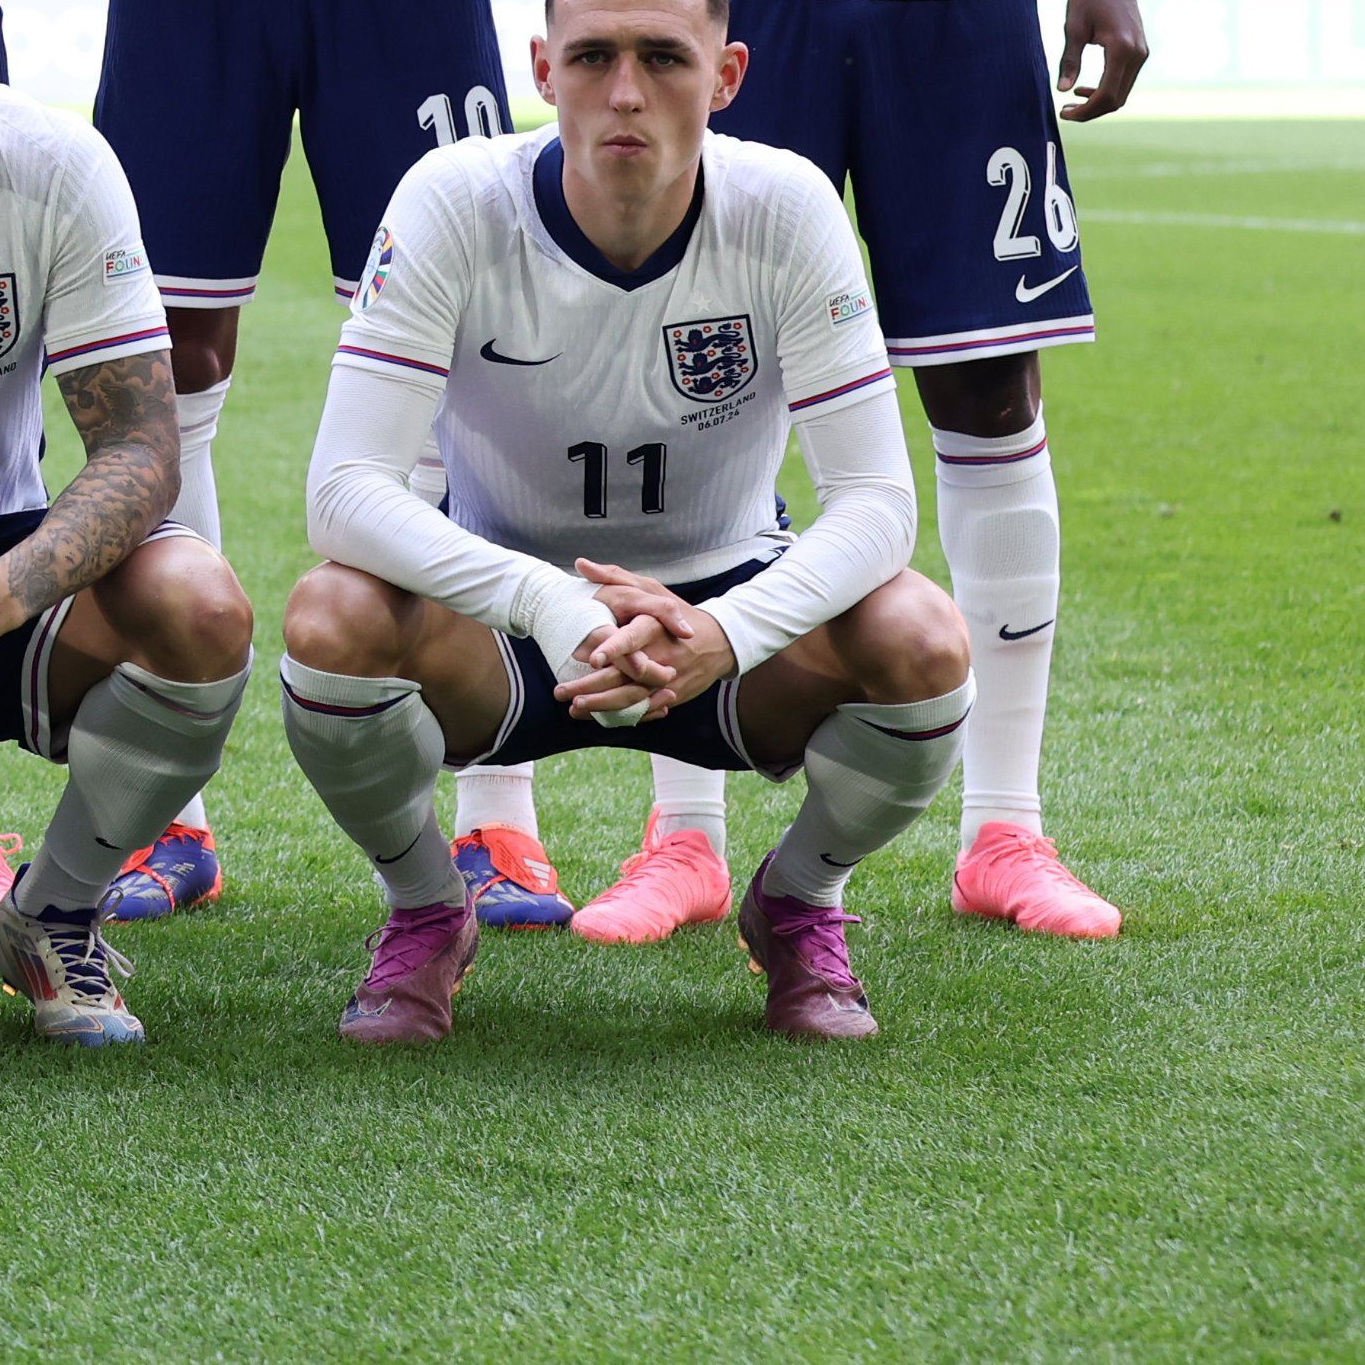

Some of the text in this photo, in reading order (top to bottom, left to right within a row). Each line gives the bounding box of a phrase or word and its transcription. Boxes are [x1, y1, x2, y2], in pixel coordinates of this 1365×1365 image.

[986, 141, 1079, 261] 26
[105, 250, 126, 260] UEFA
[106, 255, 142, 273] FOUN
[829, 295, 850, 307] UEFA
[830, 297, 868, 320] FOUN
[681, 392, 756, 425] SWITZERLAND
[698, 409, 740, 431] 06.07.24
[567, 441, 667, 518] 11
